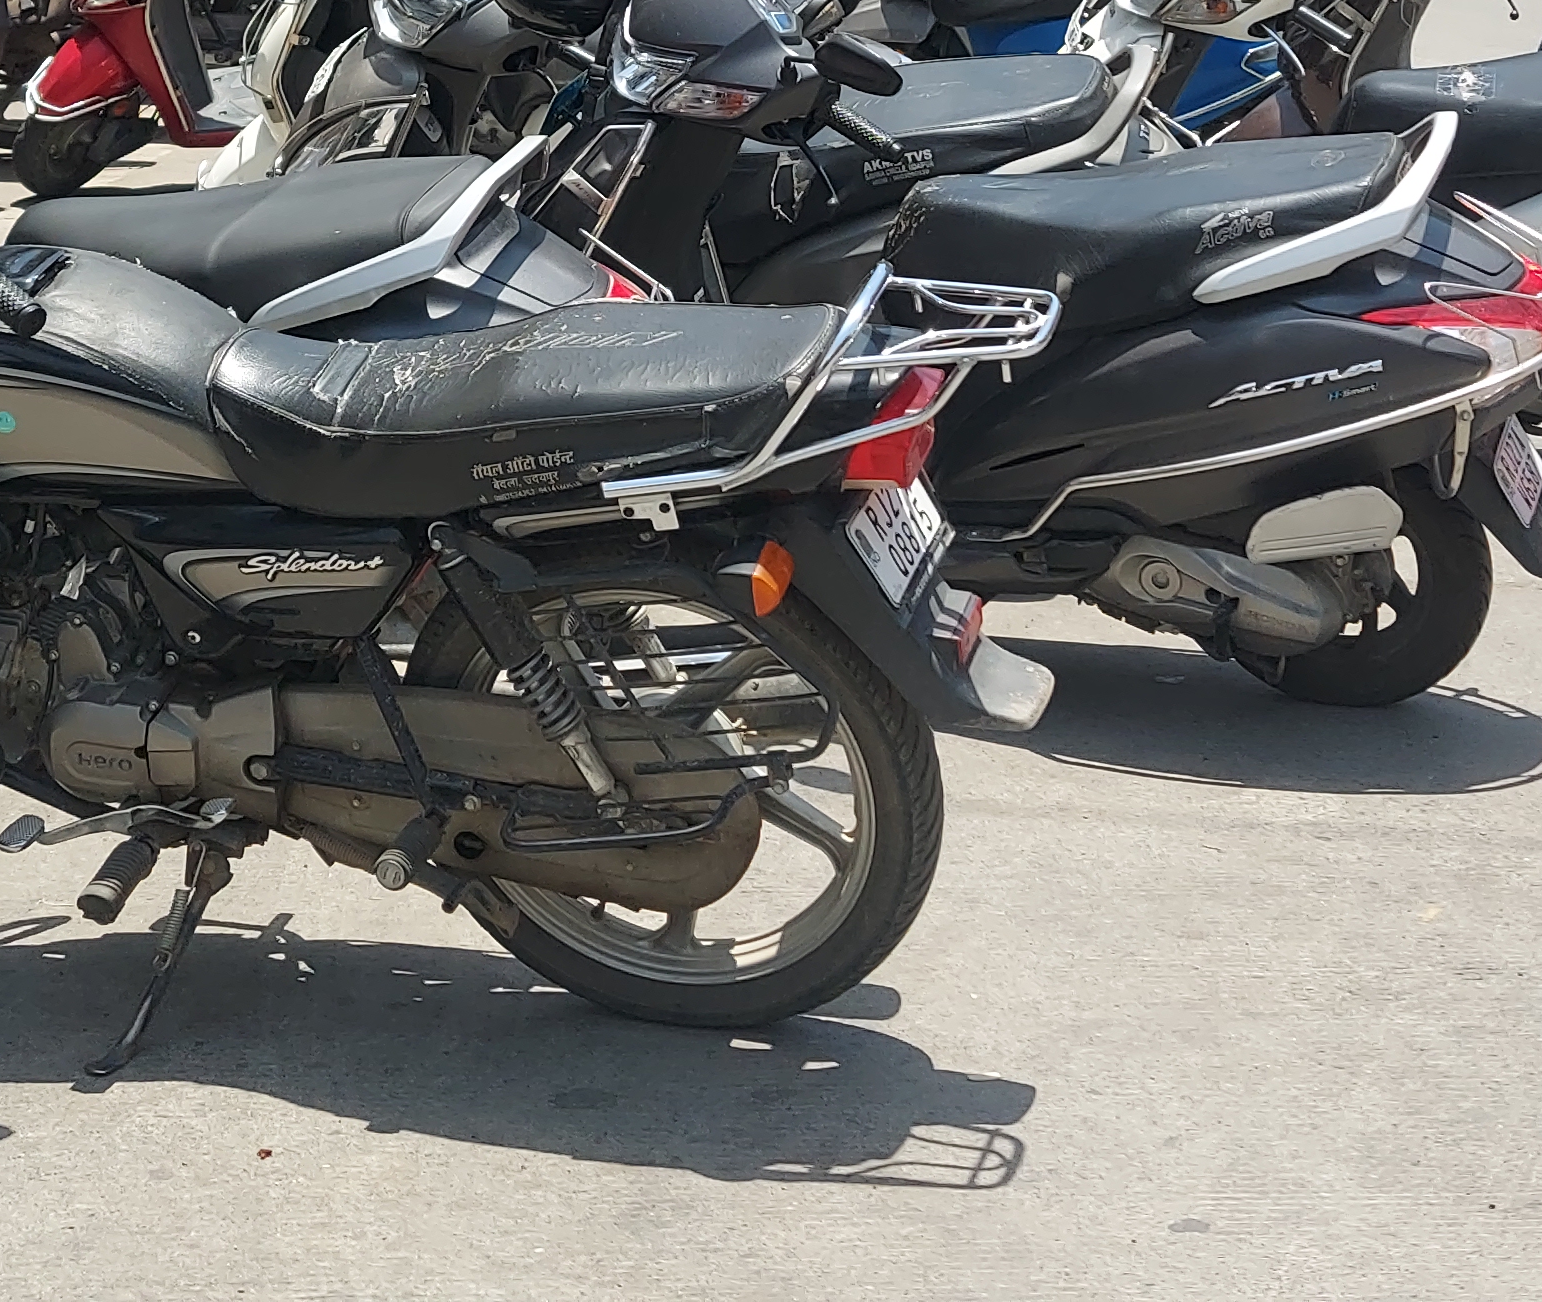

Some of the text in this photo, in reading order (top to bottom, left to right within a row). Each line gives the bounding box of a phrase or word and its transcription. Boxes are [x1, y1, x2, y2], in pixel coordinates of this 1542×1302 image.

[904, 149, 933, 163] TVS
[1228, 207, 1249, 218] NEW
[77, 751, 134, 773] Hero
